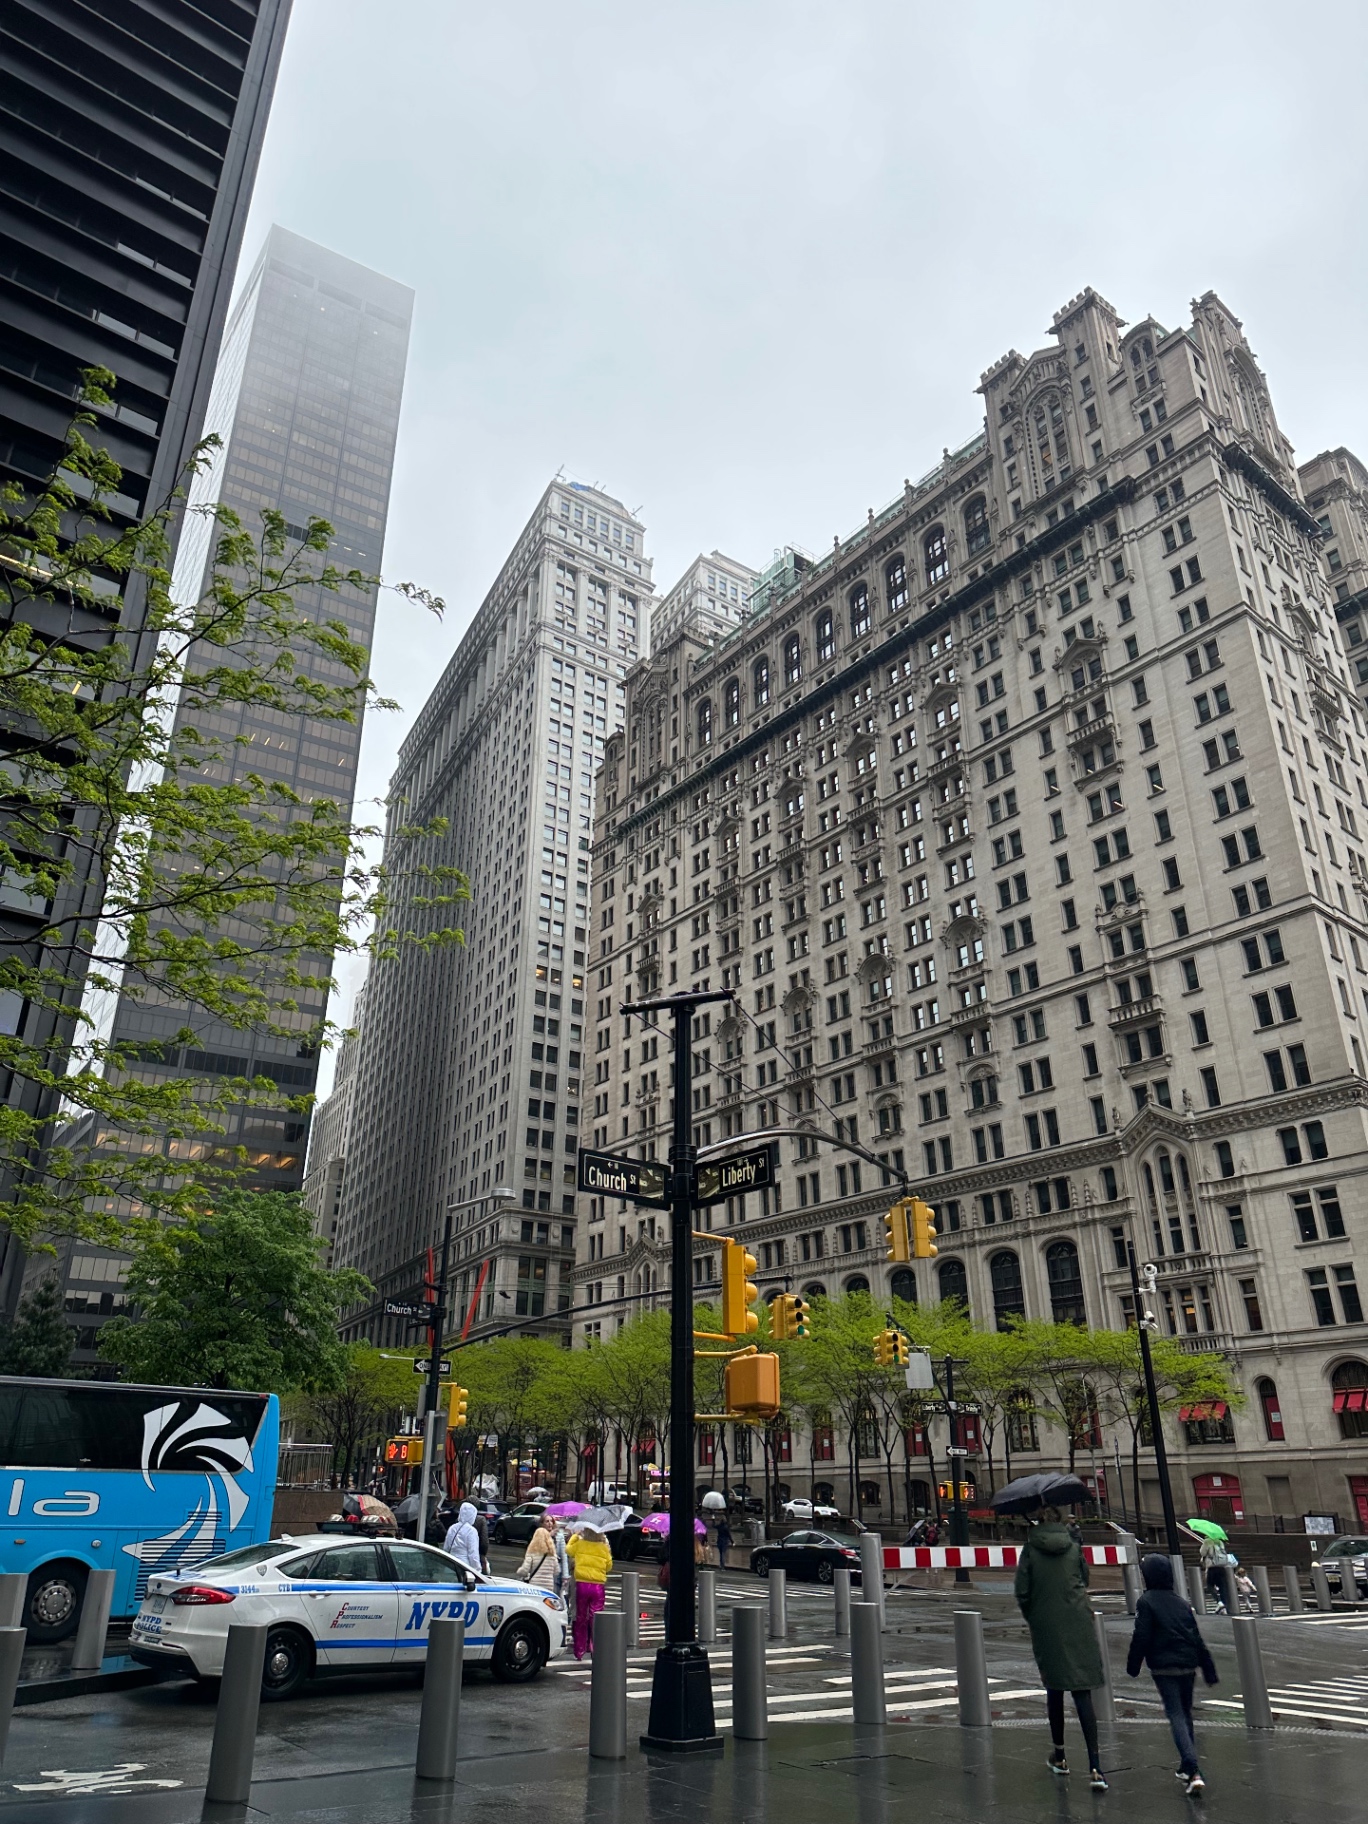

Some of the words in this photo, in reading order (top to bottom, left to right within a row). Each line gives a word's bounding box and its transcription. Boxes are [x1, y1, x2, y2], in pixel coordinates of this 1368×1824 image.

[588, 1165, 627, 1192] Church
[629, 1173, 637, 1185] St
[722, 1161, 756, 1188] Liberty
[758, 1157, 765, 1168] St
[386, 1303, 412, 1315] Church
[518, 1587, 541, 1596] POLICE
[141, 1615, 162, 1624] NYPD
[404, 1601, 480, 1631] NYPD
[136, 1622, 162, 1634] POLICE
